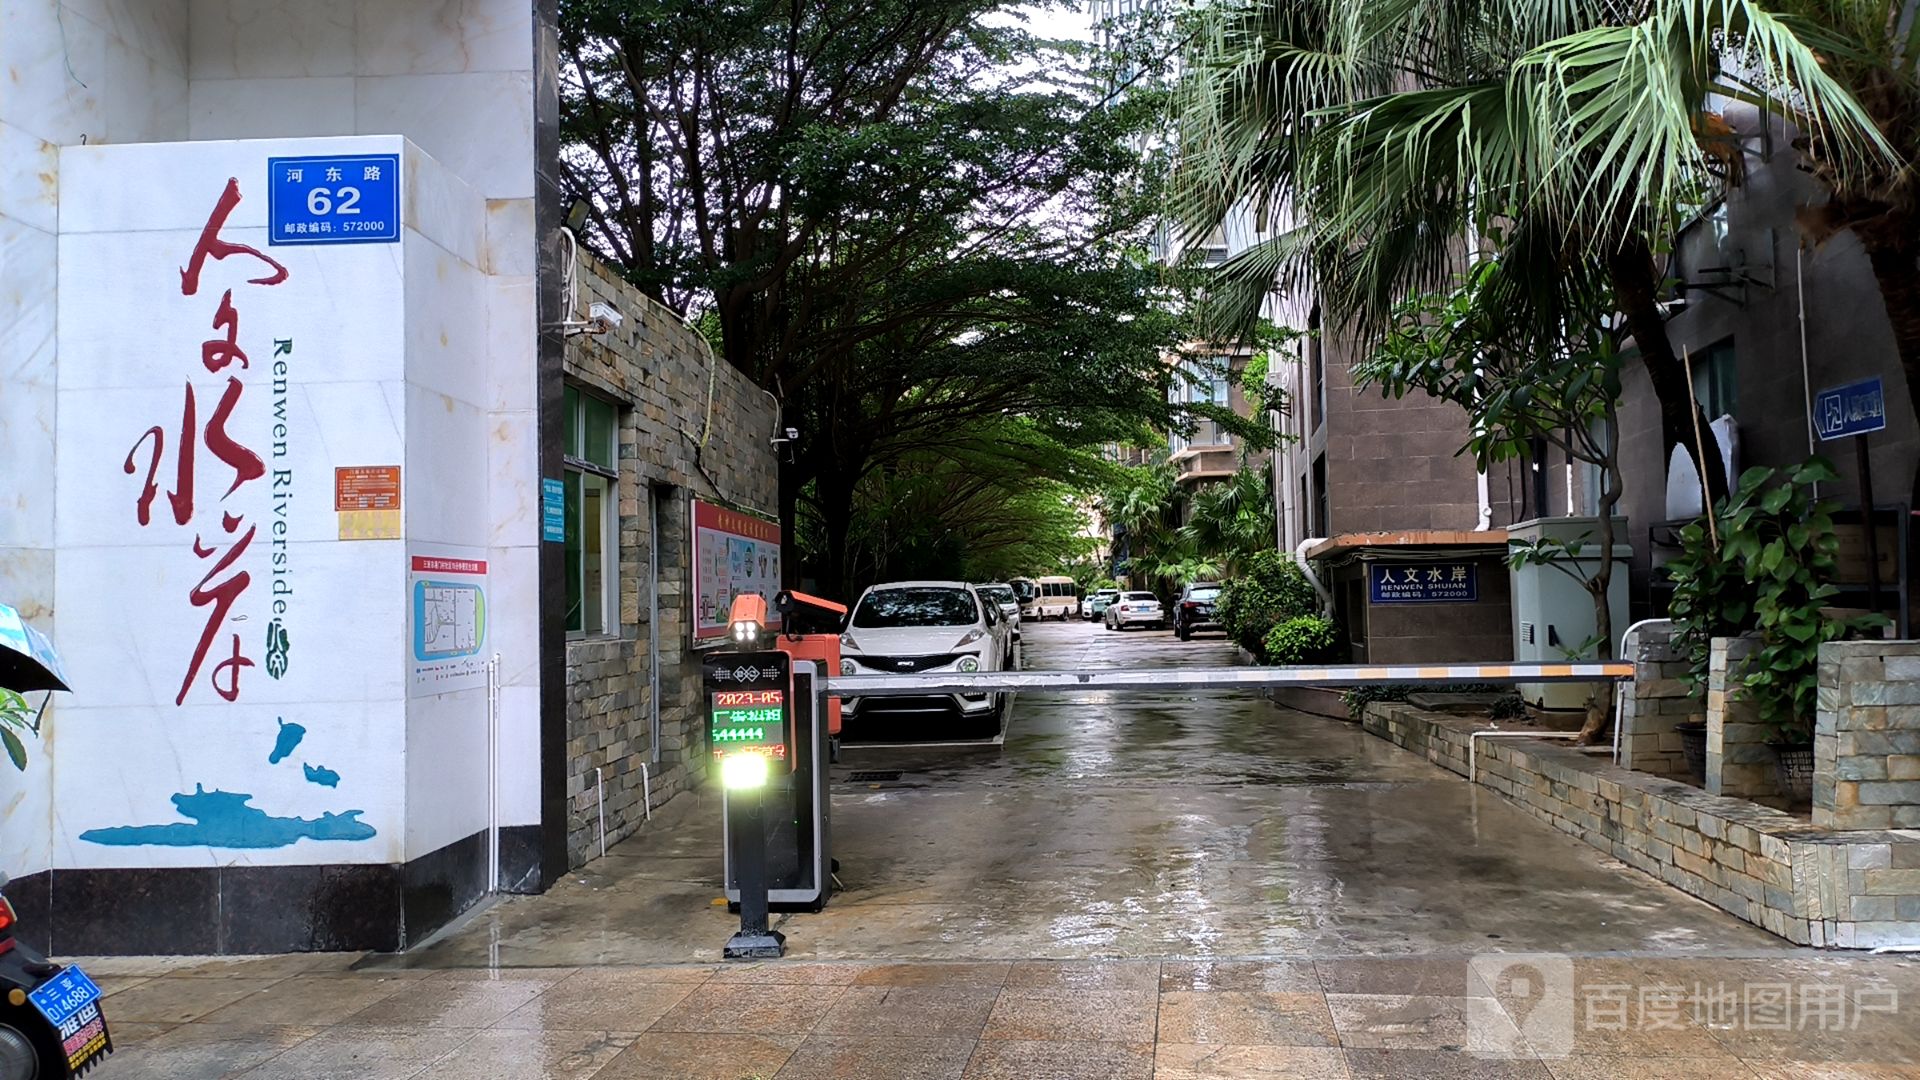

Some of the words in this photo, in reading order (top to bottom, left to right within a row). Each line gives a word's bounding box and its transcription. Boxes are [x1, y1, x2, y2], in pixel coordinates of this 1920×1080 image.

[286, 166, 381, 183] 河东路
[307, 186, 361, 215] 62
[343, 221, 385, 231] 572000
[273, 338, 292, 458] Renwen
[124, 177, 290, 706] 人文水岸
[273, 469, 293, 614] Riverside
[1380, 566, 1467, 584] 人文水岸
[46, 977, 75, 1001] 三亚
[47, 983, 95, 1021] 0146881
